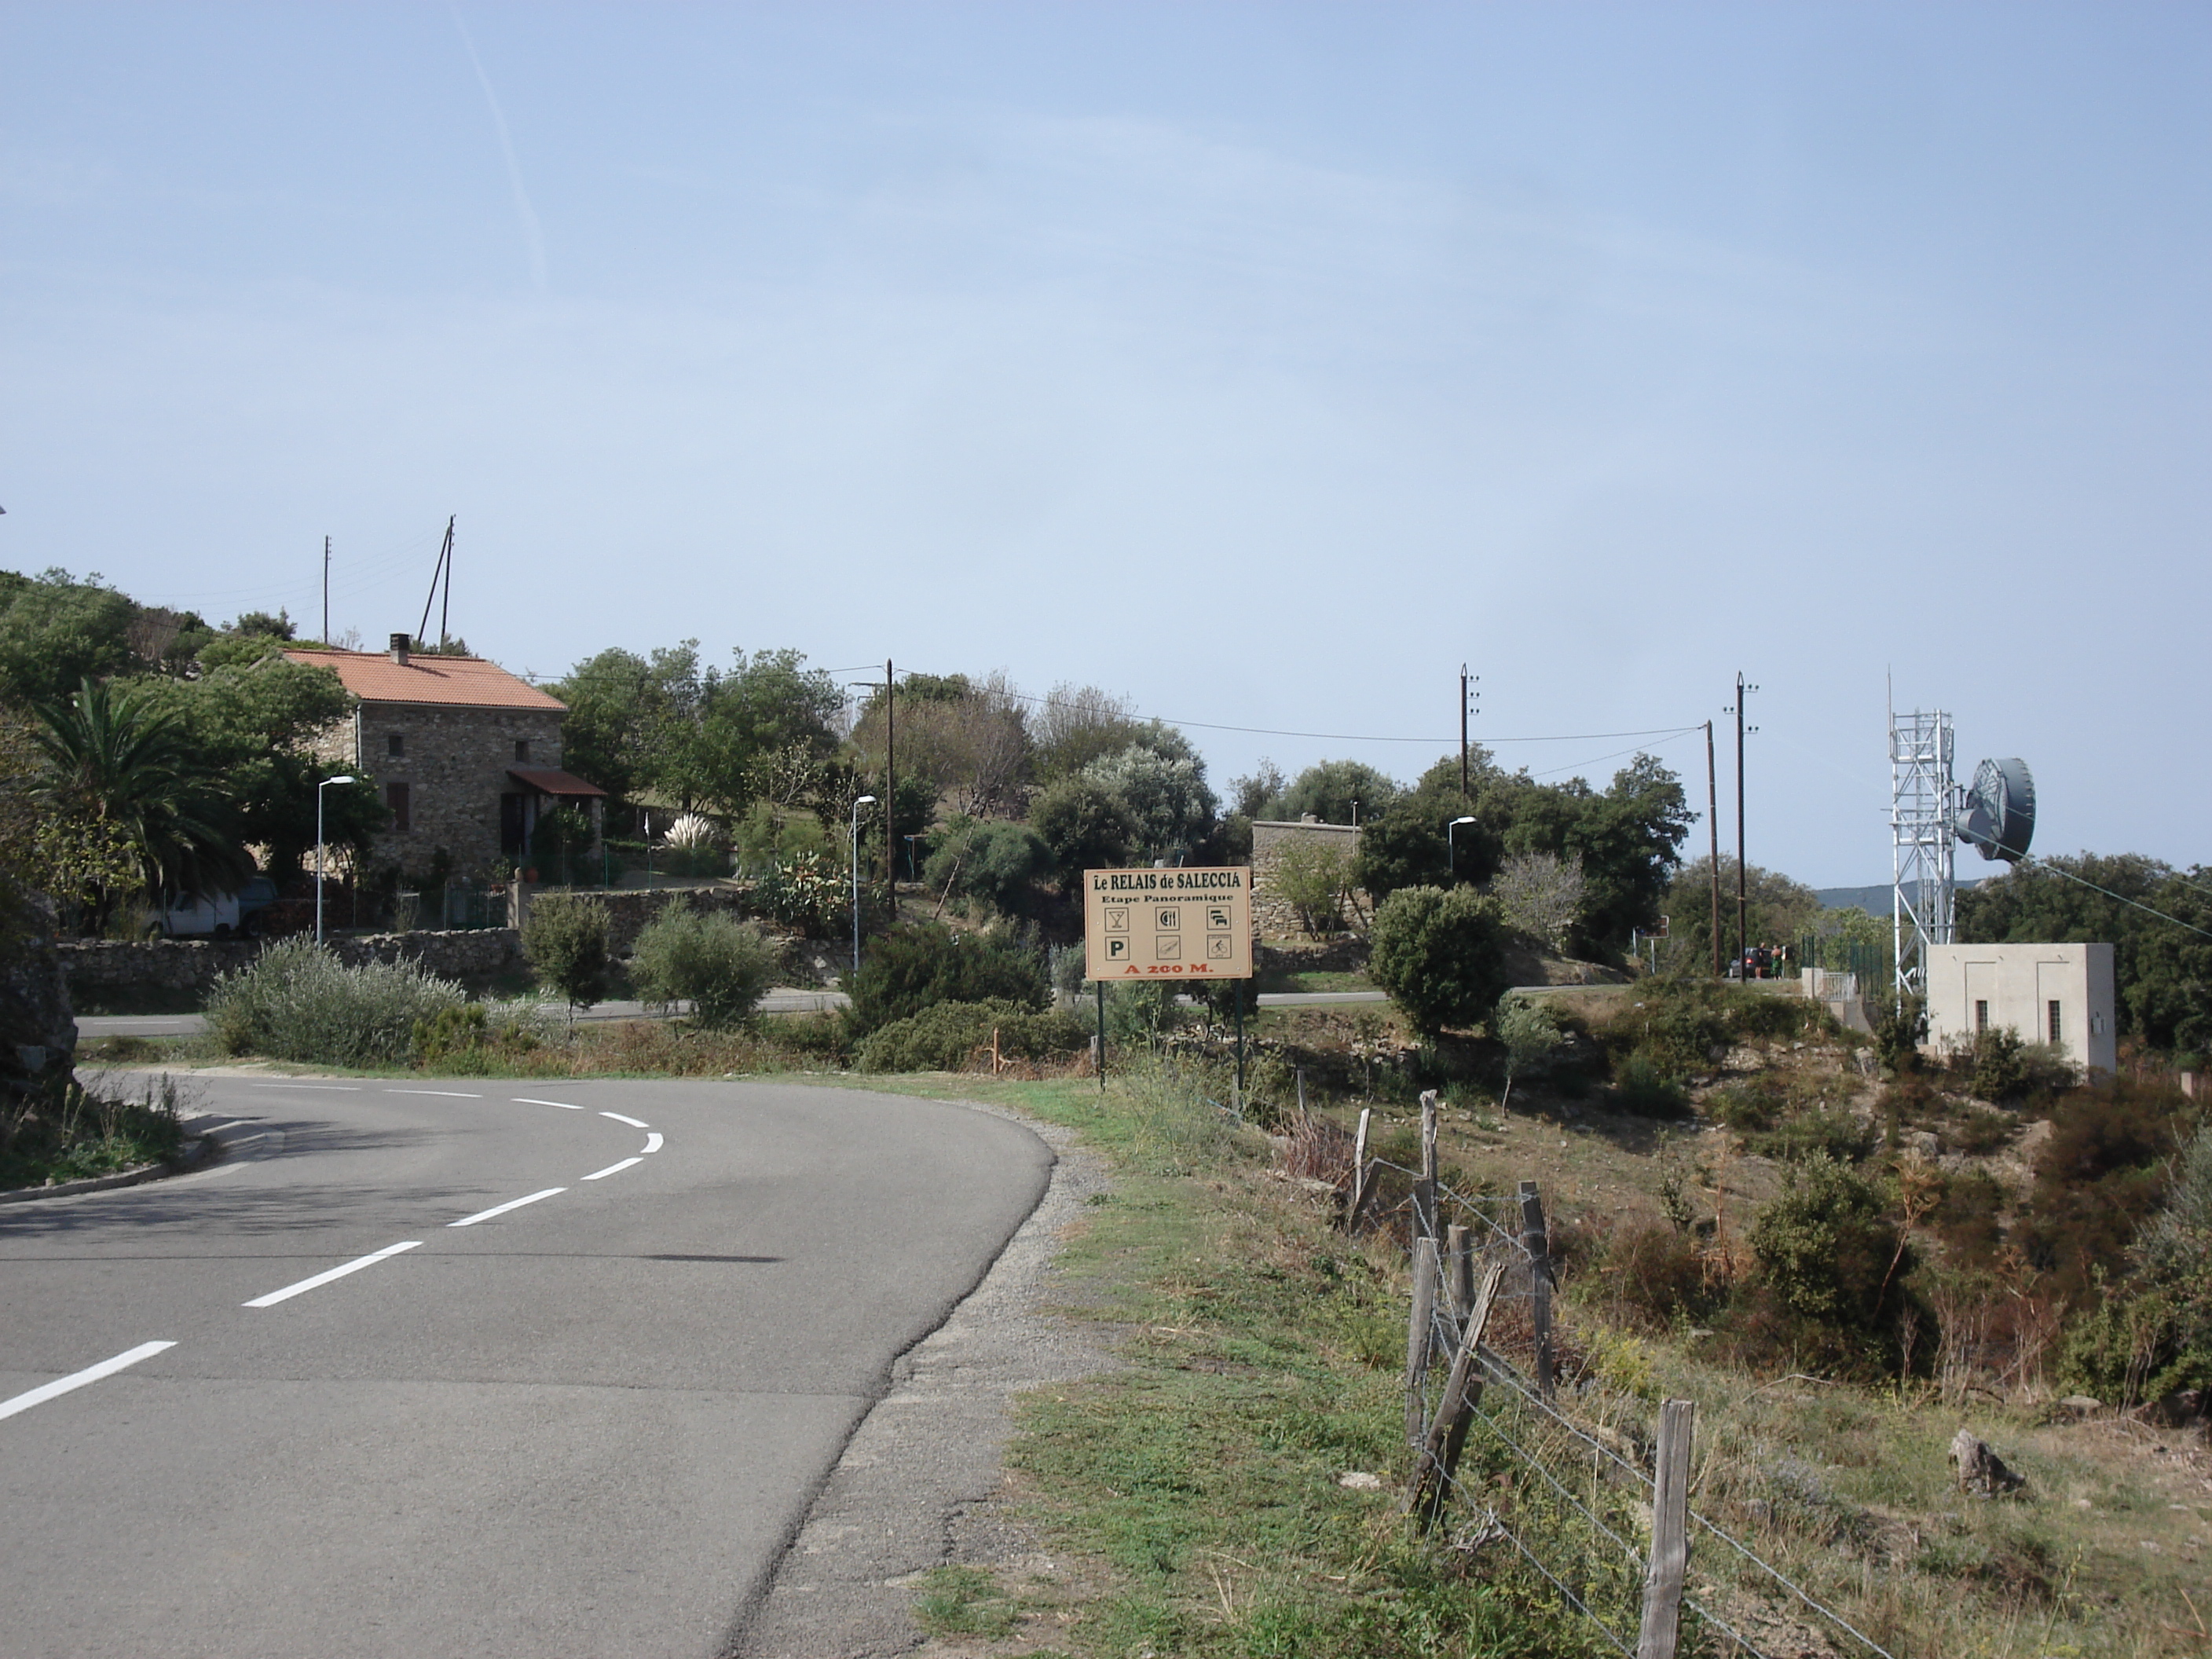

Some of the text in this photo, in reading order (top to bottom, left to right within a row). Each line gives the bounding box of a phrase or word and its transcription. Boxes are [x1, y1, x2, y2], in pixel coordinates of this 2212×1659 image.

[1093, 872, 1241, 890] Le RELAIS de SALECCIA
[1144, 894, 1233, 903] Panoramique
[1111, 941, 1124, 957] P
[1124, 963, 1214, 974] A 200 M.
